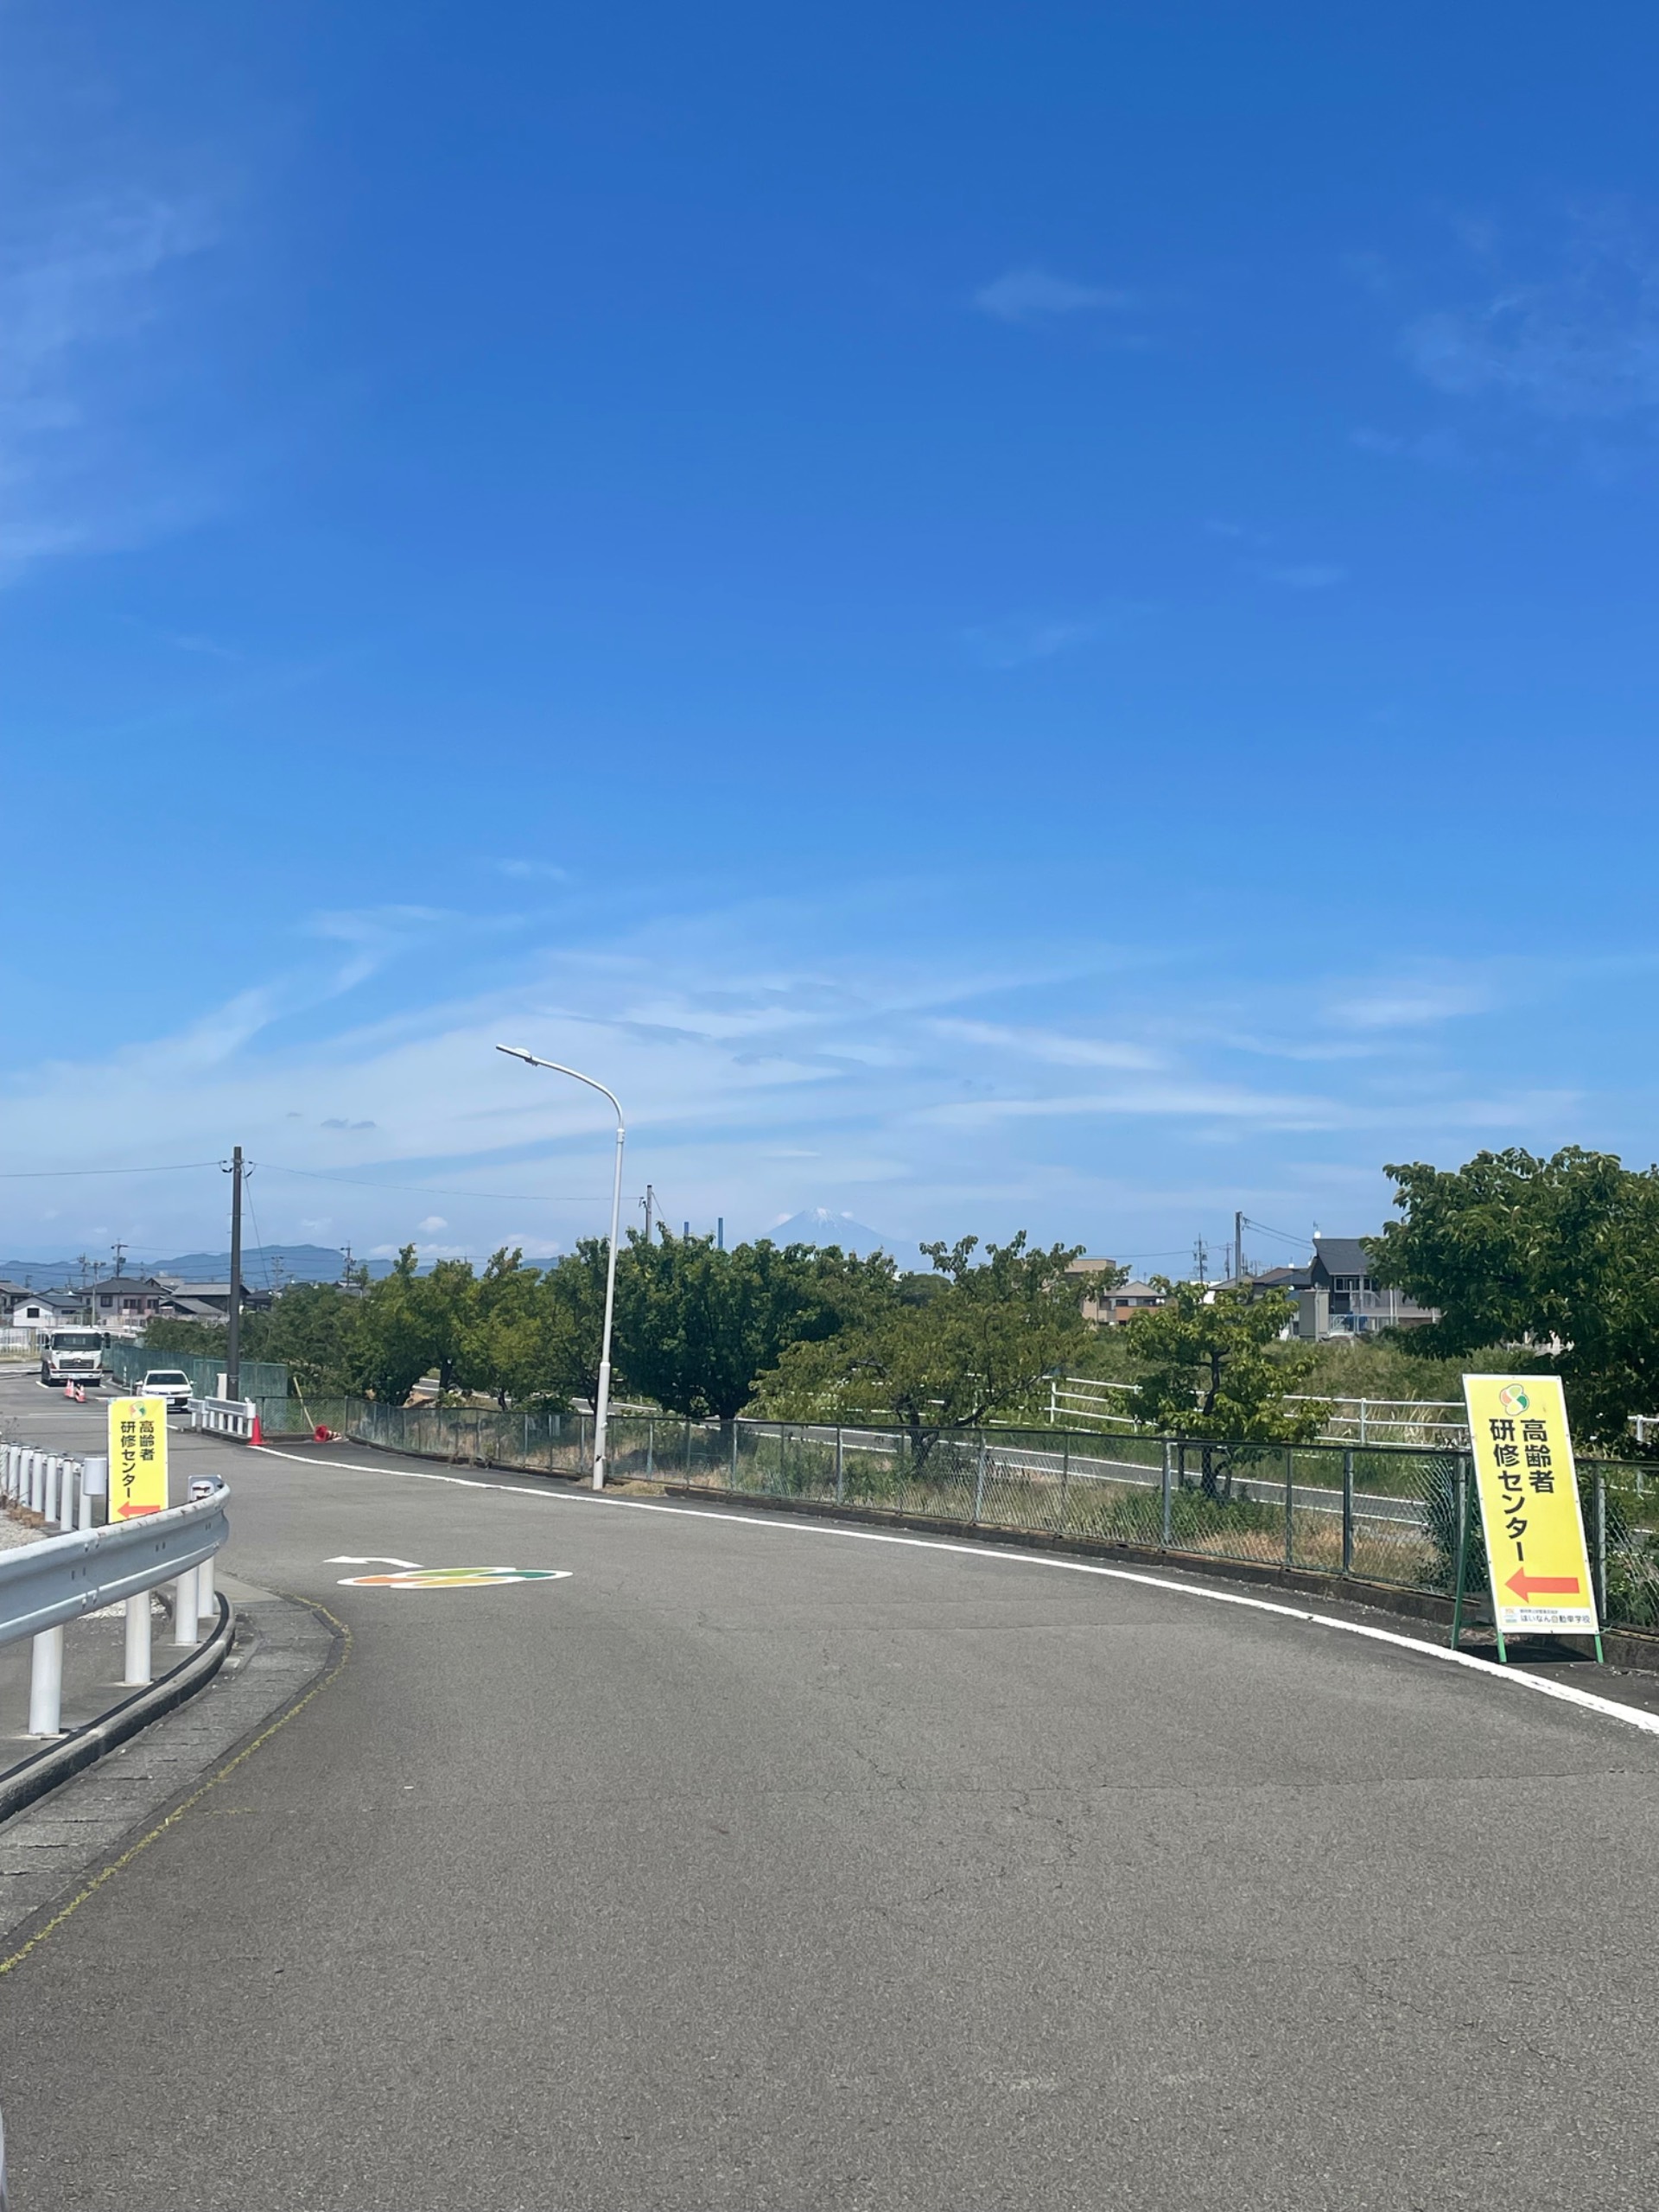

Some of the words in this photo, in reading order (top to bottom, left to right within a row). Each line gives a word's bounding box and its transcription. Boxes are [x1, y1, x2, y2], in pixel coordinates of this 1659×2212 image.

[120, 1421, 136, 1498] 研修センター
[139, 1420, 155, 1460] 高齢者
[1520, 1418, 1554, 1493] 高齢者
[1489, 1418, 1528, 1561] 研修センター
[1520, 1614, 1591, 1624] はいなん自動車学校
